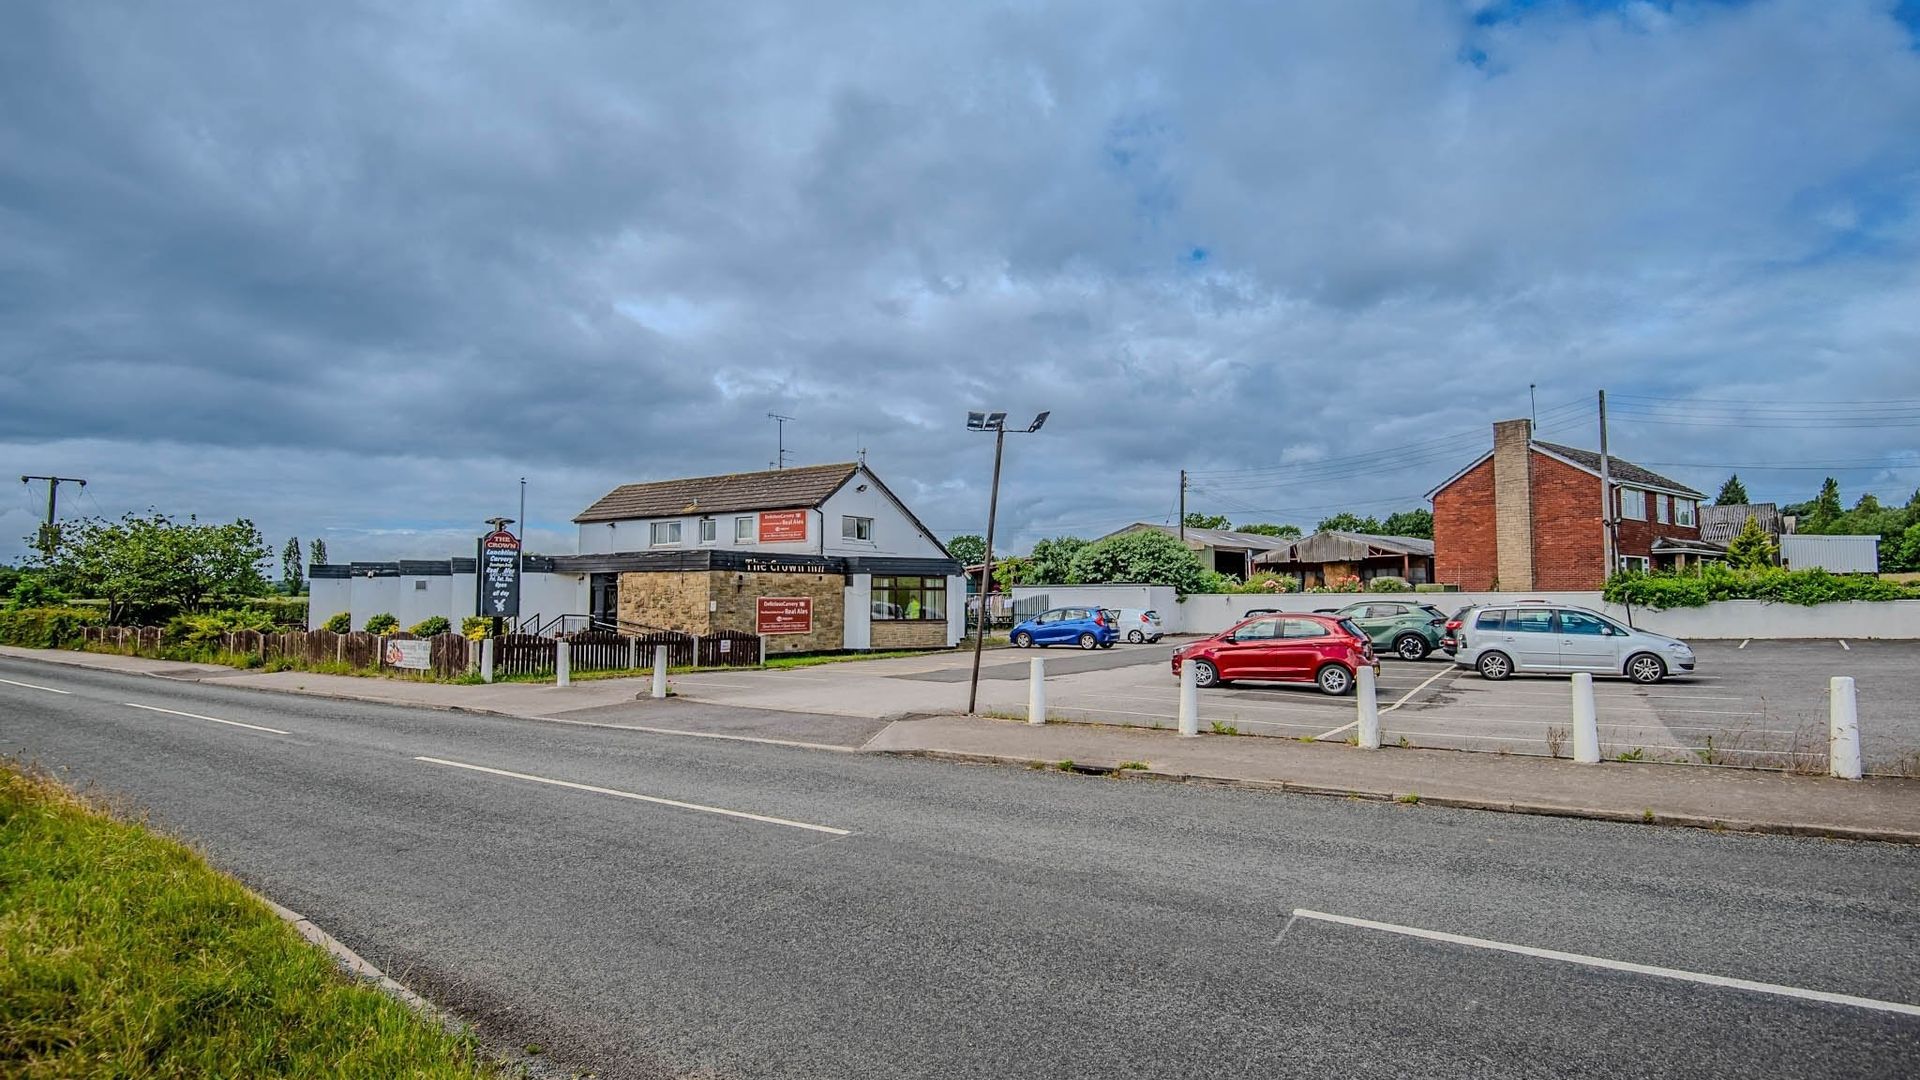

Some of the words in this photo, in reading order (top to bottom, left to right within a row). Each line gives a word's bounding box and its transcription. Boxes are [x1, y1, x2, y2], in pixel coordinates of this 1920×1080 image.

[490, 555, 514, 564] Carvery
[745, 558, 767, 571] The
[770, 559, 804, 572] Crown
